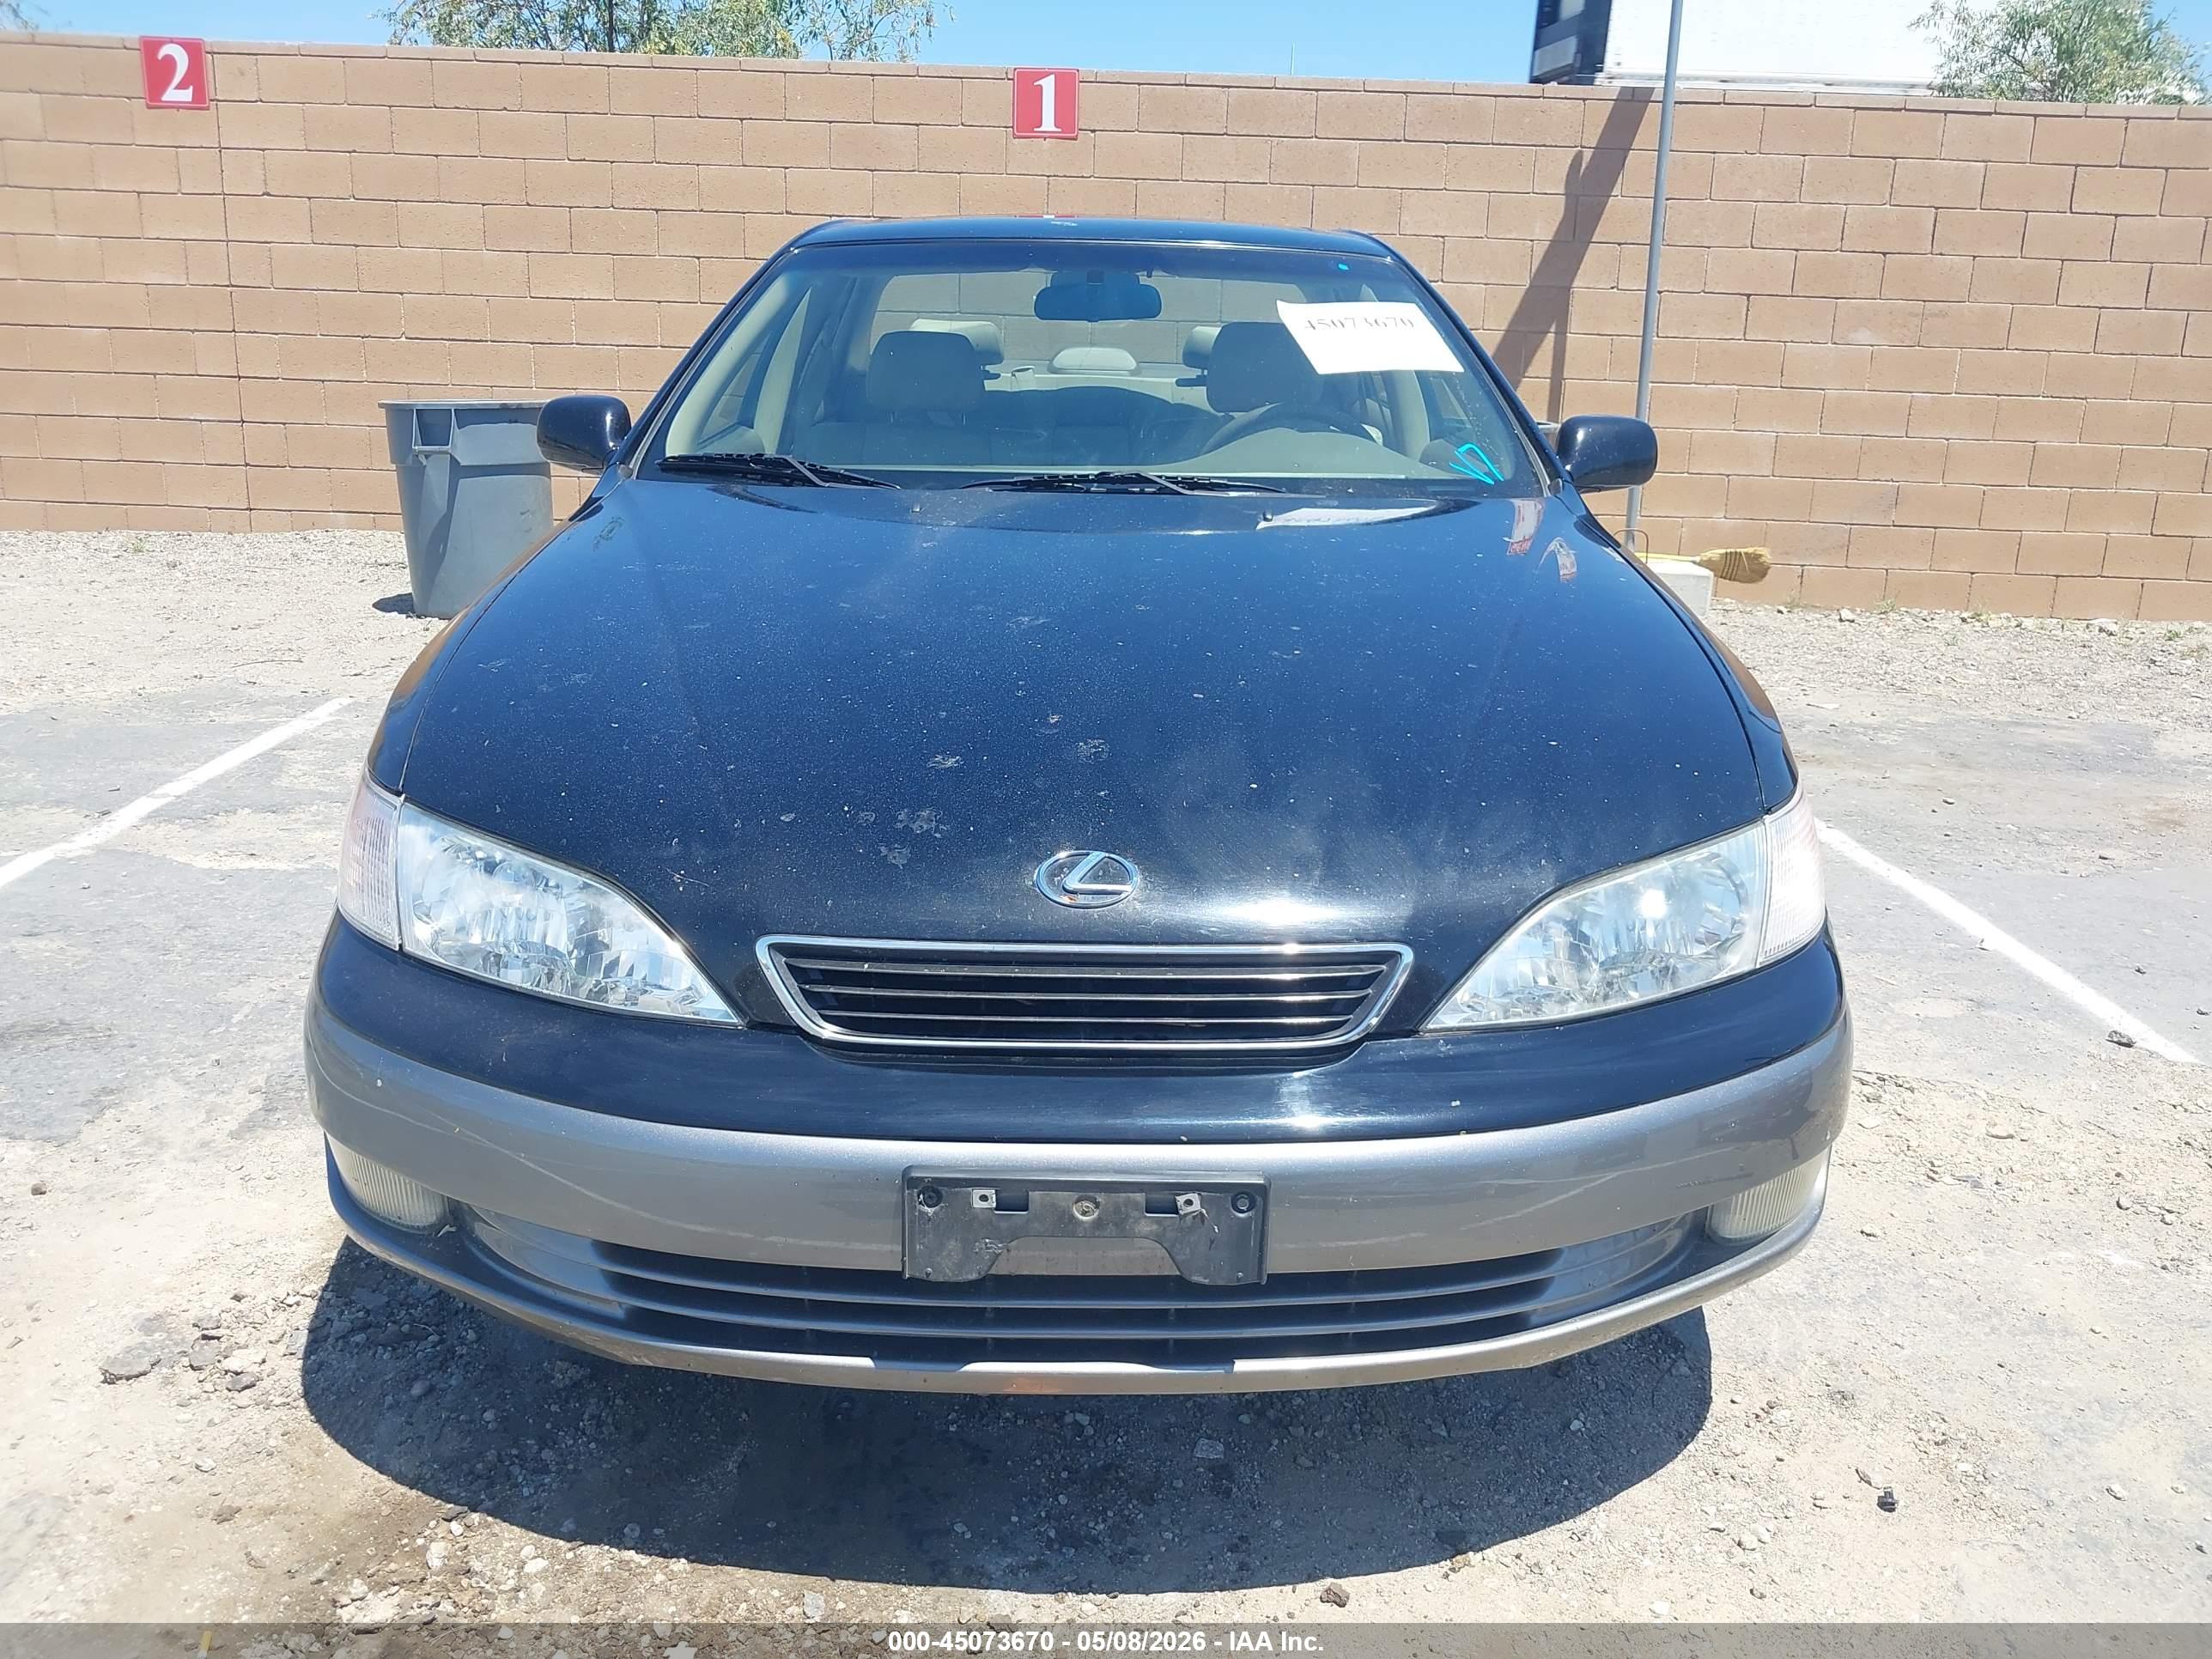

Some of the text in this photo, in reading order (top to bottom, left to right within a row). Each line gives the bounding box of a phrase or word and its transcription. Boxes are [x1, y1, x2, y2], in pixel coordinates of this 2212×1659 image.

[157, 43, 193, 102] 2
[1033, 74, 1062, 132] 1
[1304, 316, 1415, 331] 45073670
